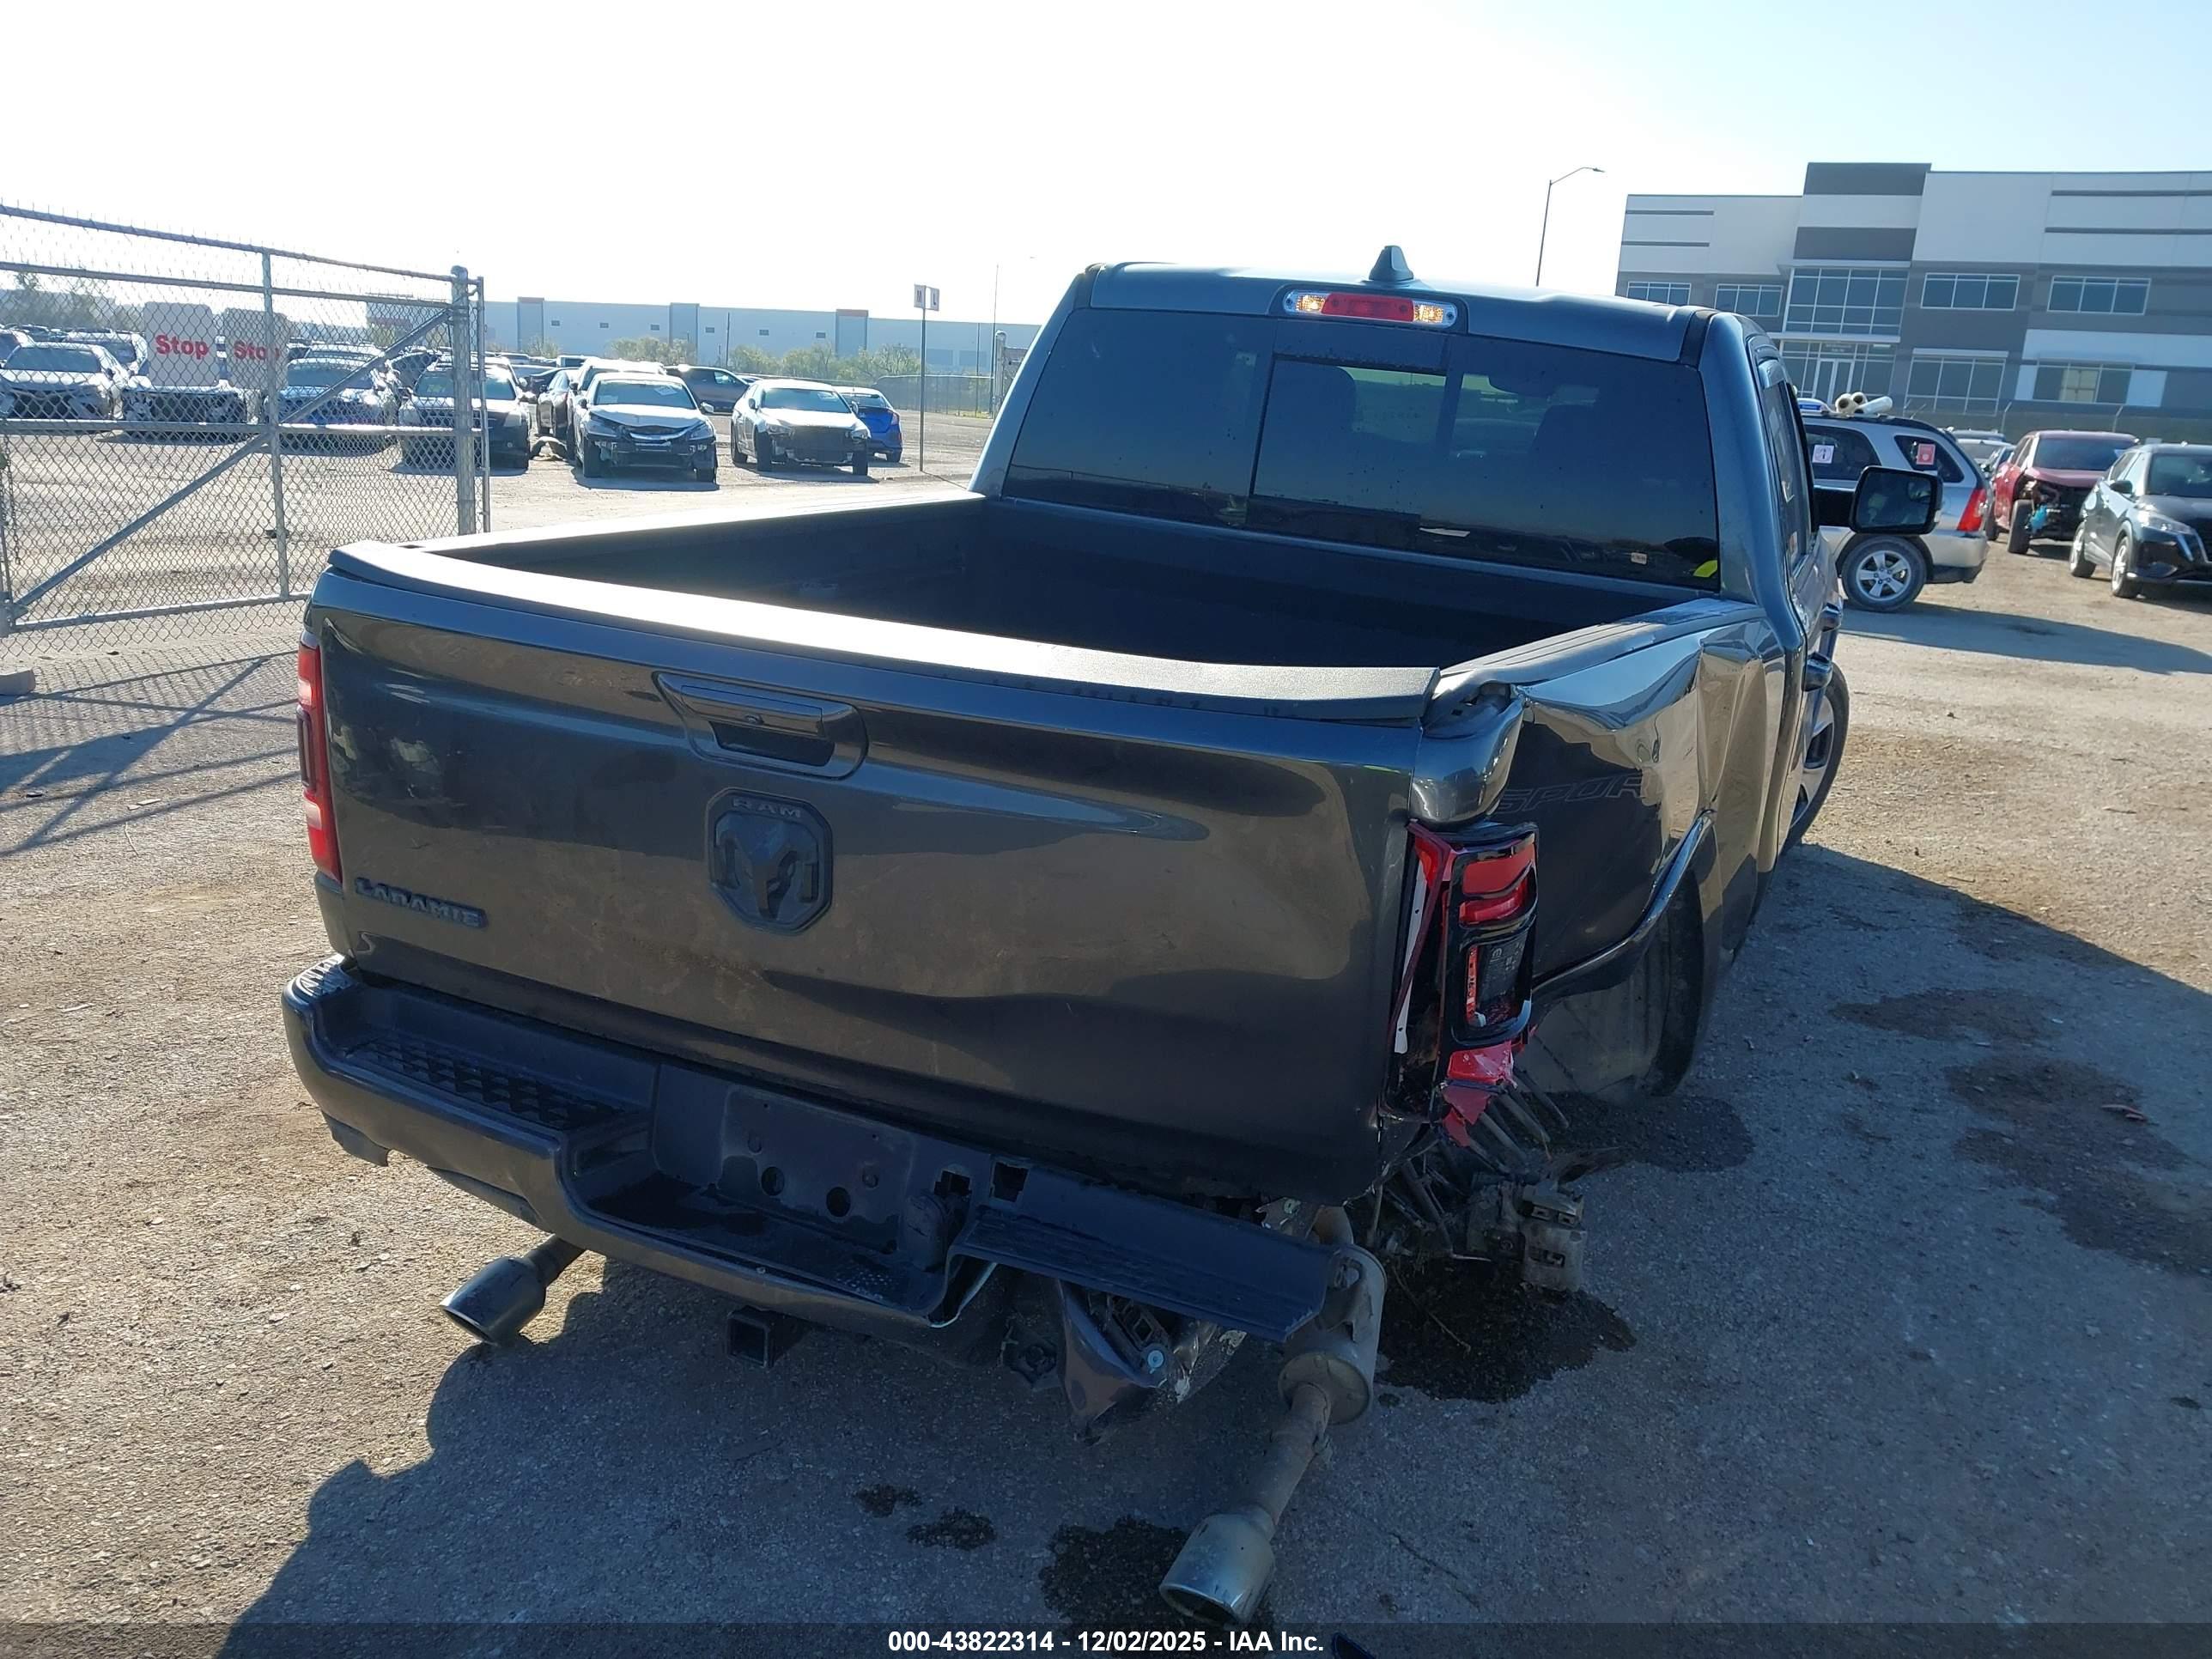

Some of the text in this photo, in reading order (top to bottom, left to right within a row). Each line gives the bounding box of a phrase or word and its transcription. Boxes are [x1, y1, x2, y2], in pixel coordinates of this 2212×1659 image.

[155, 334, 210, 359] Stop
[732, 797, 802, 819] RAM
[1493, 772, 1659, 815] SPOR
[355, 877, 489, 929] LARAMIE
